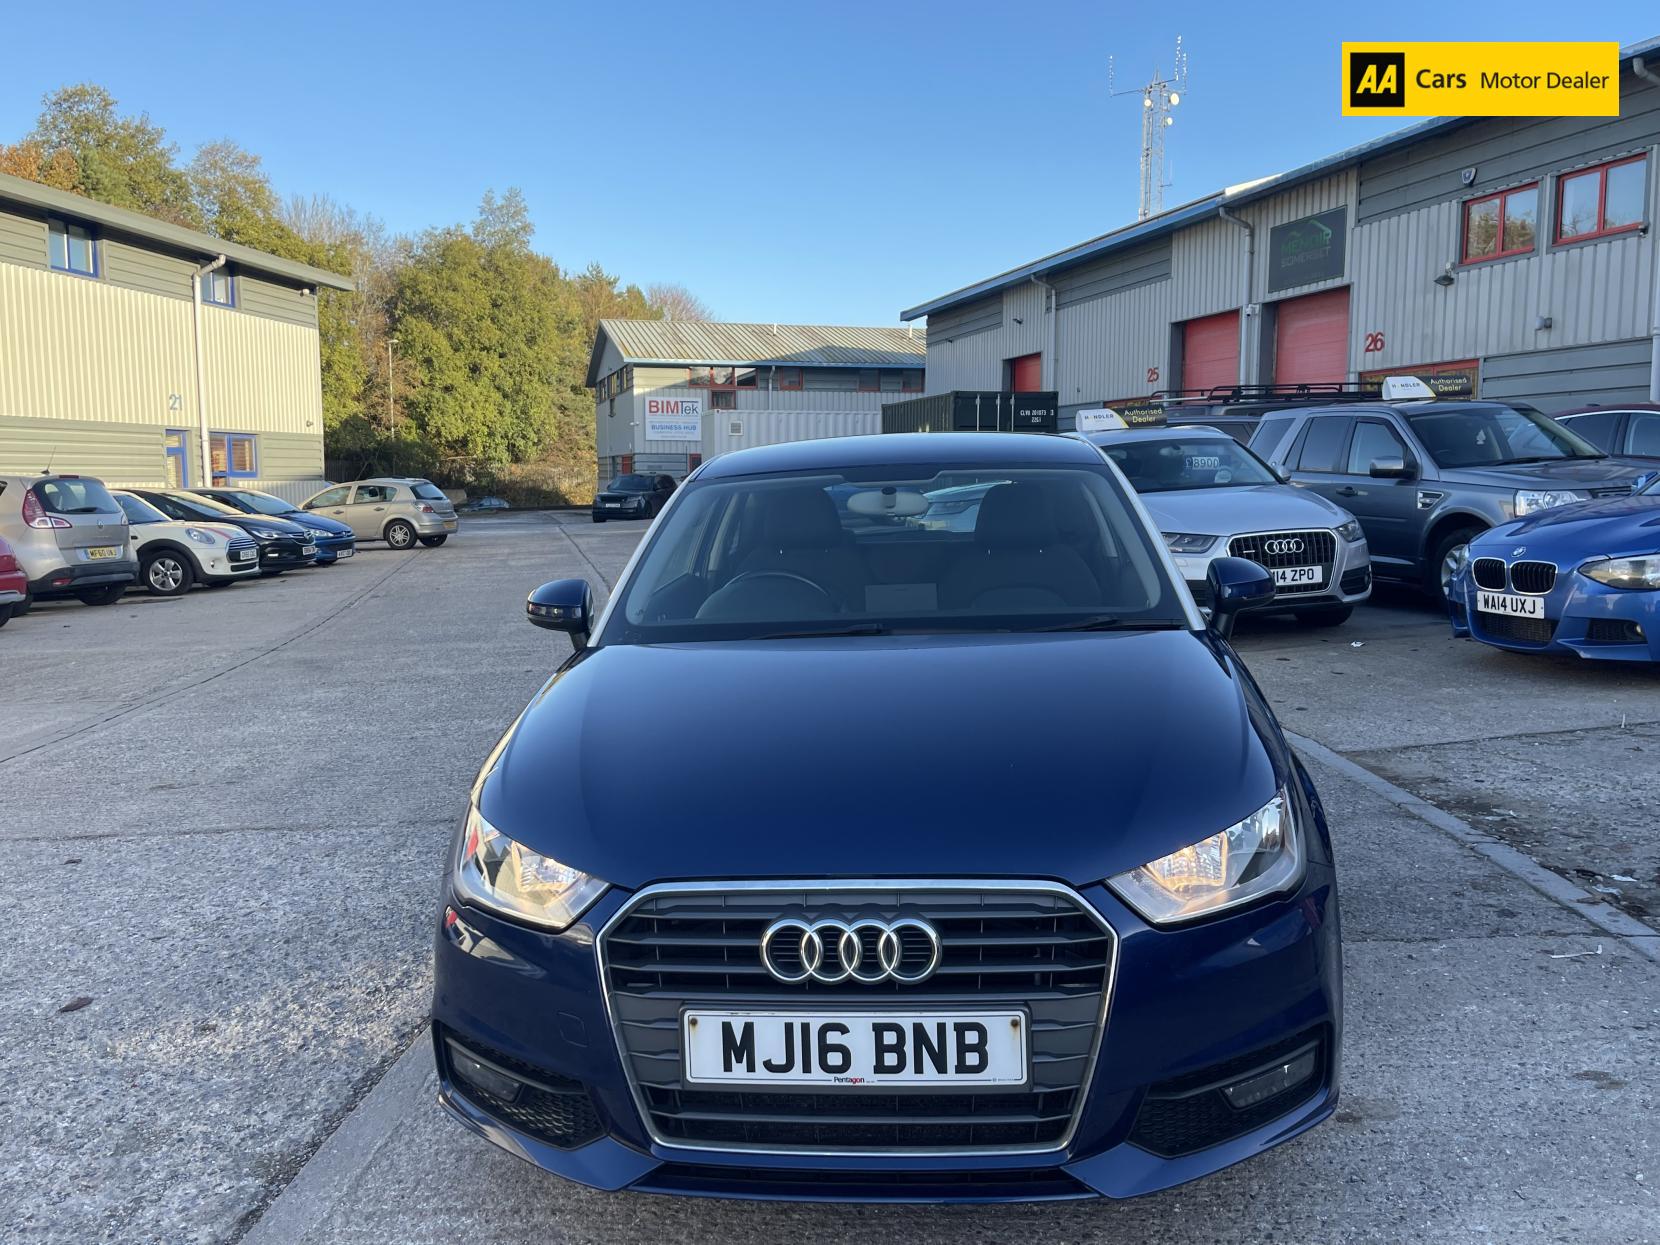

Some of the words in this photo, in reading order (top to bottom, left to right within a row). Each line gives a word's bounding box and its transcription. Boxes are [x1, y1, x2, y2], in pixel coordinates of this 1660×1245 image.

[1365, 332, 1385, 352] 26
[1147, 368, 1159, 382] 25
[1430, 377, 1467, 385] Authorised
[1438, 384, 1462, 392] Dealer
[169, 394, 182, 410] 21
[649, 400, 698, 415] BIMTek
[1125, 408, 1163, 416] Authorised
[1133, 415, 1155, 423] Dealer
[1184, 457, 1219, 469] £8900
[1272, 569, 1287, 583] 14
[1291, 568, 1314, 582] ZPO
[1484, 594, 1507, 611] WA14
[1511, 598, 1536, 614] UXJ
[721, 1021, 852, 1074] MJ16
[872, 1022, 989, 1074] BNB
[833, 1076, 865, 1084] Pentagon
